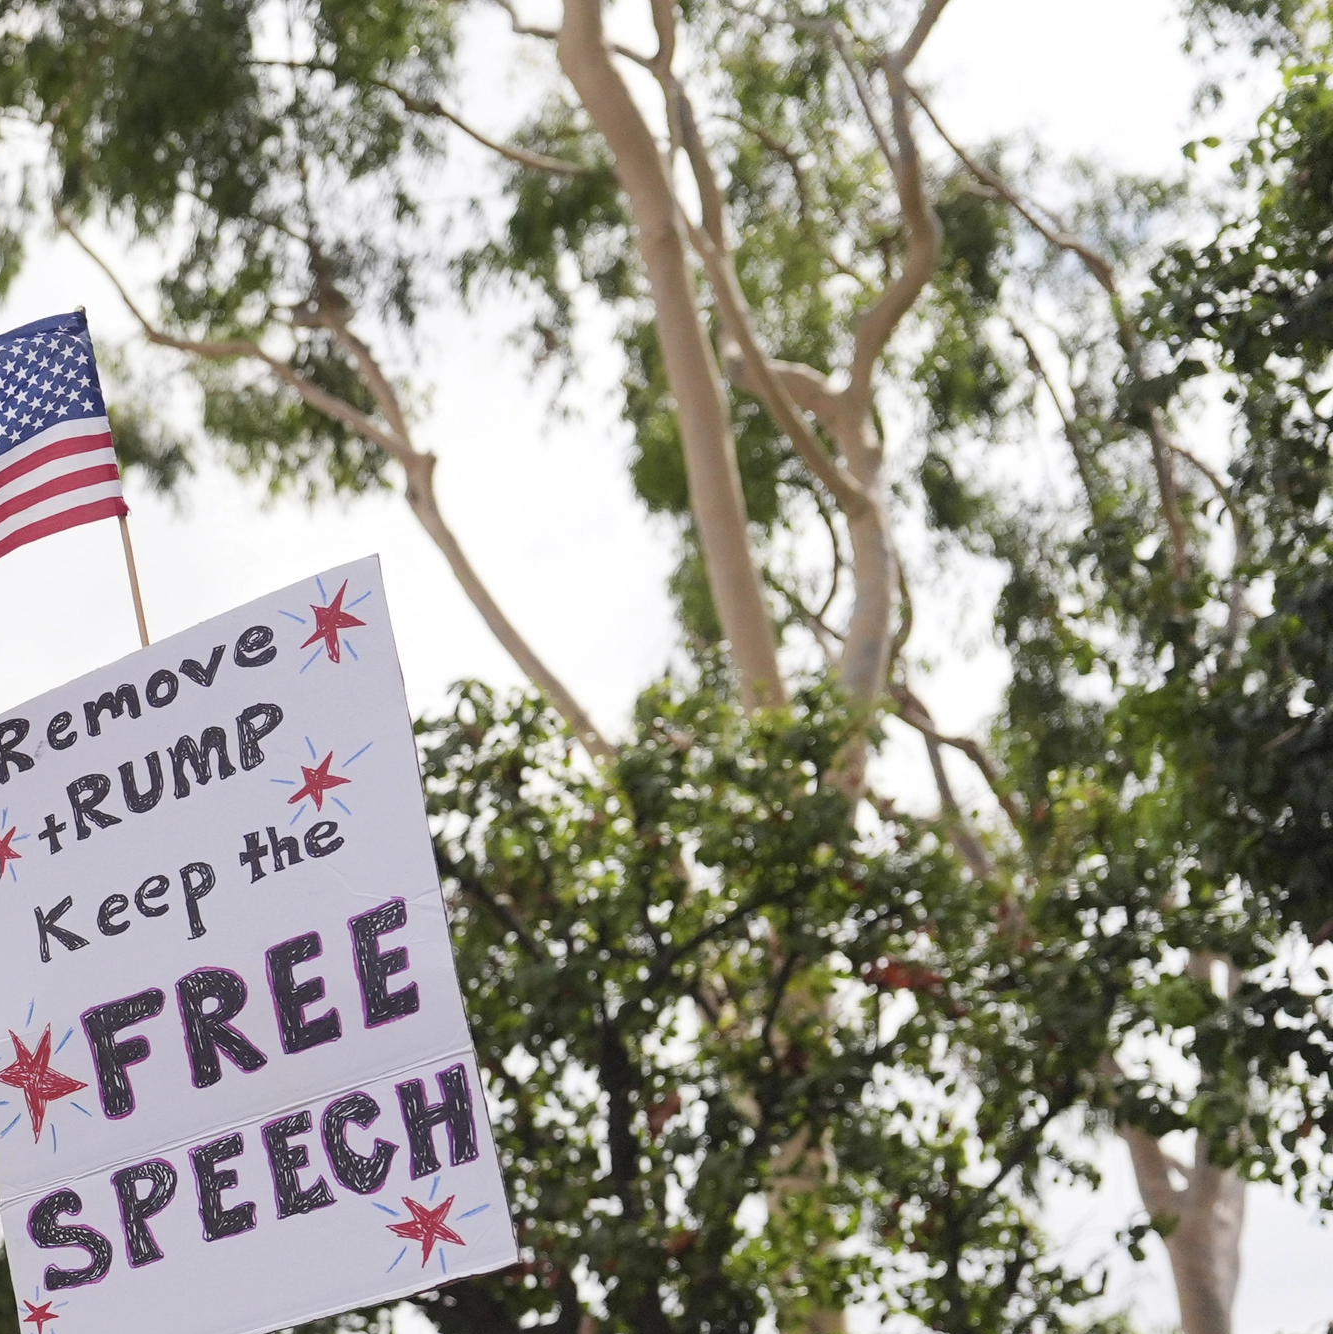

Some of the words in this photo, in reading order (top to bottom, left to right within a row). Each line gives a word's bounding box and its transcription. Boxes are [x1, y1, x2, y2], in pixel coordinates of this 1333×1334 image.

[35, 861, 214, 963] Keep
[240, 815, 345, 885] the
[80, 896, 420, 1121] FREE
[26, 1061, 479, 1291] SPEECH
